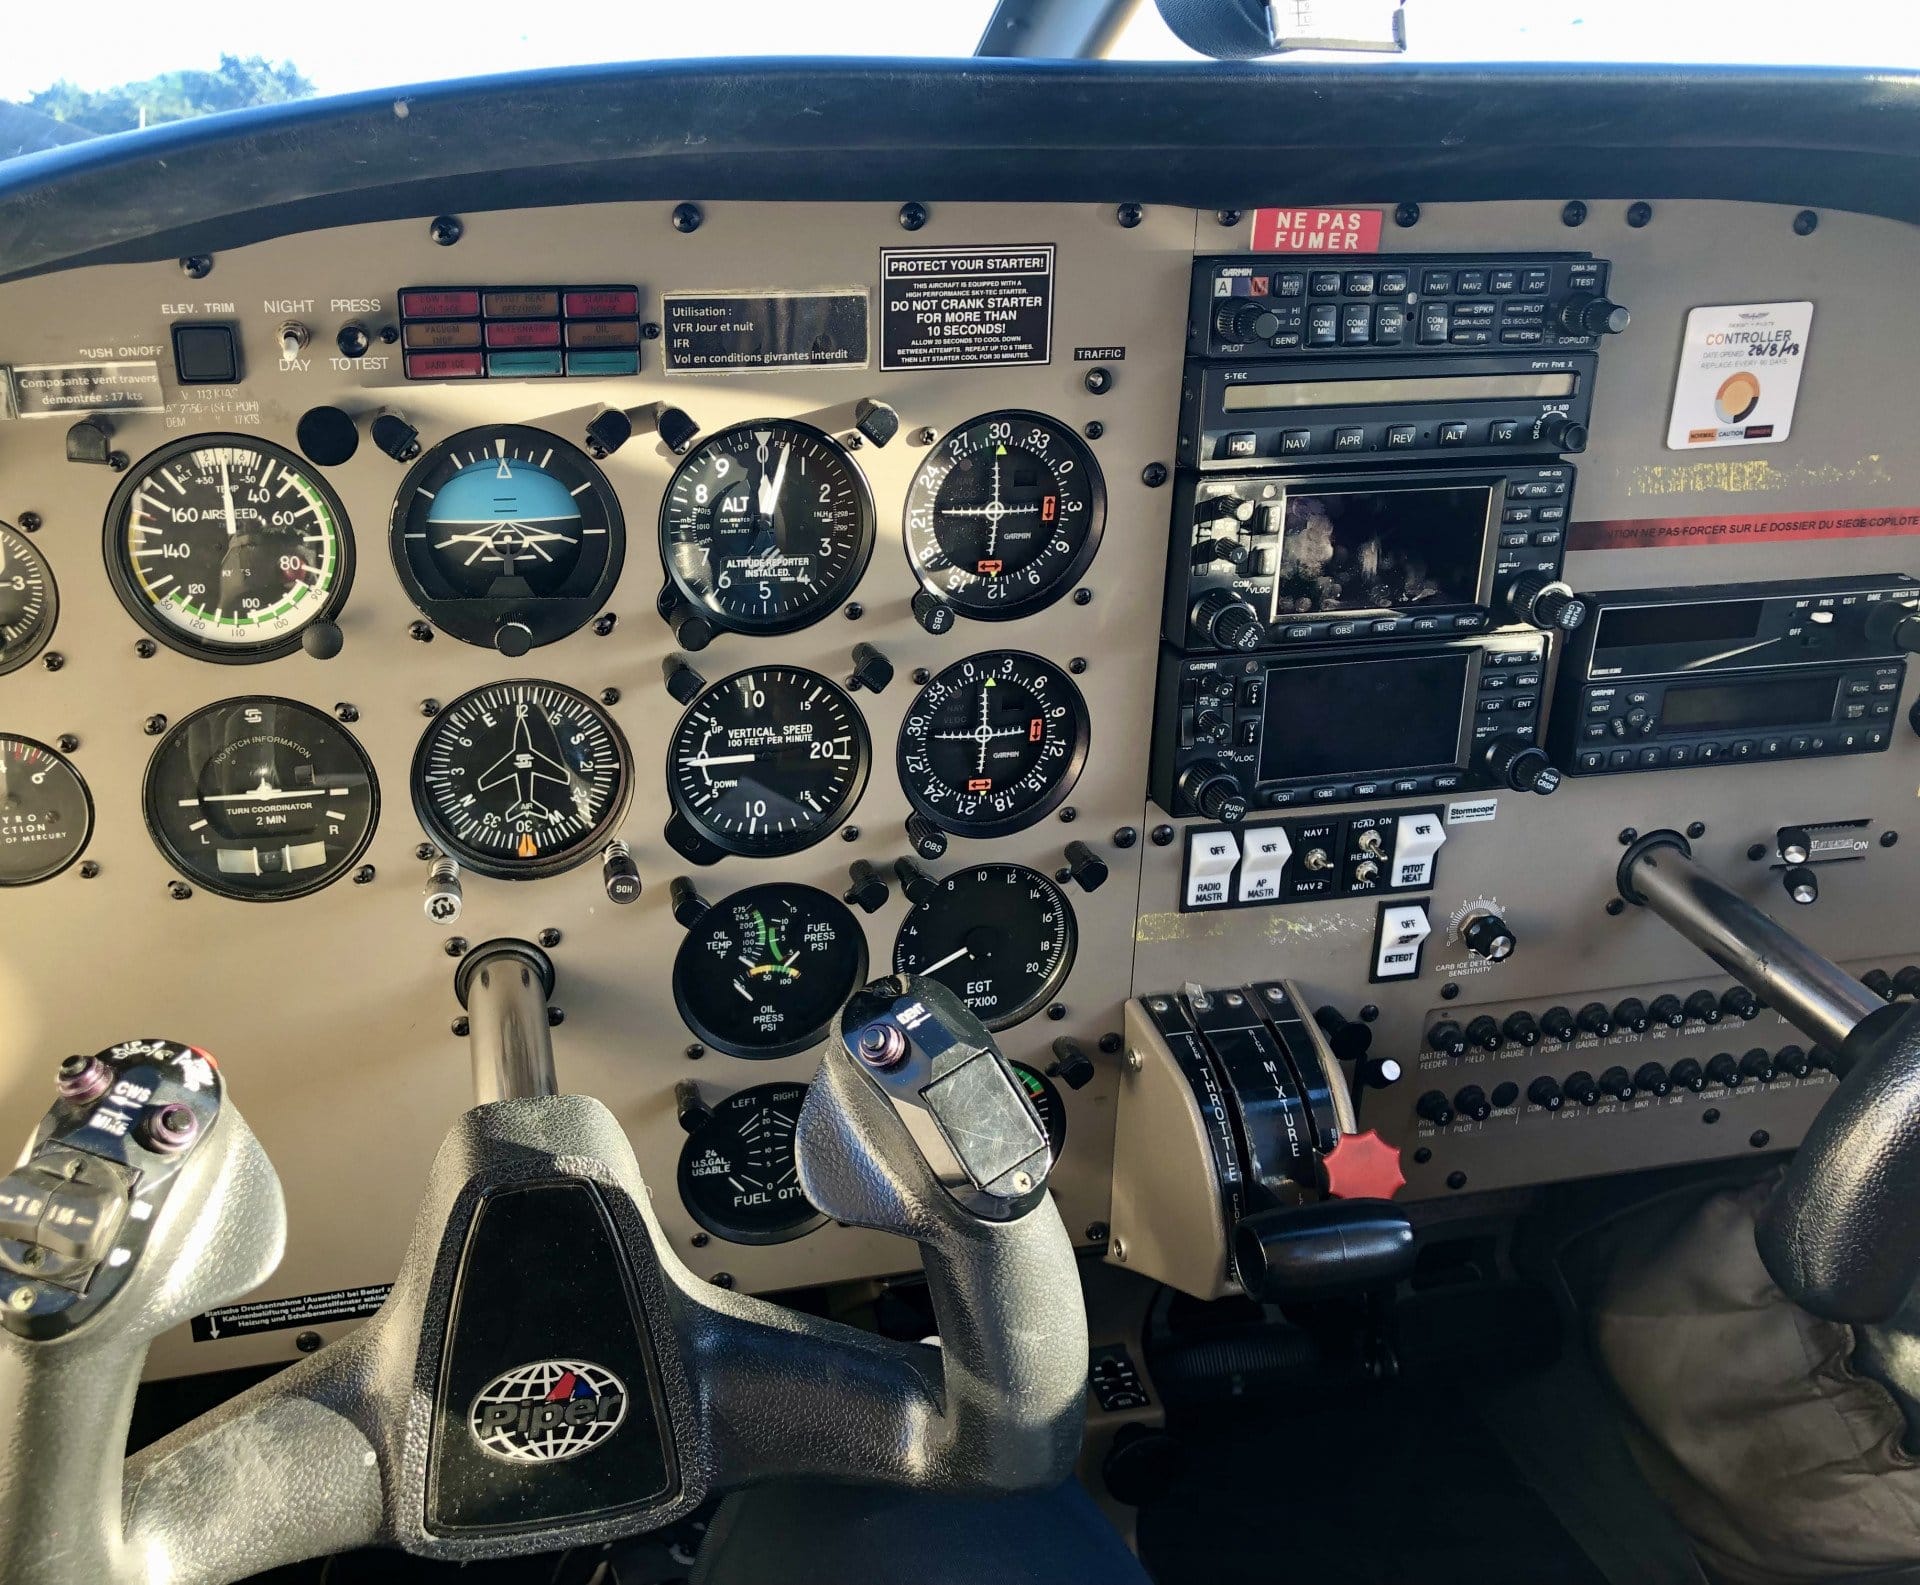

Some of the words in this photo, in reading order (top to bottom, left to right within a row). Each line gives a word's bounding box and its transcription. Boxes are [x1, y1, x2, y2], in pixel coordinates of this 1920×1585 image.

[1277, 212, 1307, 228] NE
[1318, 213, 1361, 229] PAS
[1275, 232, 1358, 249] FUMER
[891, 260, 946, 272] PROTECT
[951, 260, 983, 270] YOUR
[987, 258, 1043, 269] STARTER!
[162, 303, 198, 314] ELEV.
[205, 302, 234, 312] TRIM
[264, 300, 314, 313] NIGHT
[331, 299, 381, 312] PRESS
[891, 302, 909, 311] DO
[913, 300, 938, 310] NOT
[941, 299, 984, 309] CRANK
[988, 297, 1042, 308] STARTER
[673, 307, 726, 317] Utilisation
[917, 313, 941, 323] FOR
[946, 312, 980, 322] MORE
[984, 310, 1017, 320] THAN
[673, 323, 693, 332] VFR
[696, 323, 718, 332] Jour
[721, 323, 731, 332] et
[733, 322, 753, 331] nuit
[927, 326, 940, 336] 10
[944, 324, 1005, 335] SECONDS!
[1706, 330, 1792, 345] CONTROLLER
[674, 339, 689, 348] IFR
[674, 354, 691, 364] Vol
[709, 353, 761, 363] conditions
[764, 352, 809, 363] givrantes
[812, 349, 848, 360] interdit
[1078, 350, 1122, 358] TRAFFIC
[279, 359, 311, 371] DAY
[352, 357, 389, 370] TEST
[21, 379, 89, 388] Composante
[93, 377, 117, 385] vent
[118, 375, 157, 383] travers
[1224, 372, 1248, 381] S-TEC
[127, 392, 143, 400] kts
[989, 423, 1010, 439] 30
[1446, 430, 1464, 440] ALT
[1499, 430, 1512, 440] VS
[1286, 438, 1307, 448] NAV
[1340, 436, 1360, 446] APR
[1393, 433, 1413, 443] REV
[1232, 440, 1253, 451] HDG
[248, 489, 270, 503] 40
[722, 497, 749, 512] ALT
[172, 508, 198, 522] 160
[202, 509, 258, 520] AIRSEED
[272, 511, 294, 525] 60
[1543, 510, 1562, 518] MENU
[1641, 528, 1657, 537] NE
[1658, 527, 1680, 536] PAS
[1682, 525, 1727, 535] FORCER
[1729, 524, 1752, 533] SUR
[1754, 523, 1767, 532] LE
[1770, 520, 1817, 532] DOSSIER
[1819, 520, 1833, 529] DU
[1836, 518, 1867, 529] SIEGE
[1868, 516, 1918, 527] COPILOTE
[1510, 537, 1524, 545] CLR
[1543, 535, 1556, 543] ENT
[163, 544, 190, 558] 140
[280, 556, 300, 570] 80
[727, 559, 764, 568] ALTITUDE
[764, 558, 809, 567] REPORTER
[1538, 562, 1554, 571] GPS
[746, 569, 790, 577] INSTALLED.
[1421, 621, 1434, 629] FPL
[1459, 618, 1478, 626] PROC
[1336, 626, 1351, 635] OBS
[1190, 662, 1217, 671] GARMIN
[744, 690, 765, 709] 10
[728, 727, 775, 738] VERTICAL
[783, 724, 813, 735] SPEED
[728, 739, 742, 747] 100
[744, 737, 764, 746] FEET
[767, 736, 783, 745] PER
[785, 734, 812, 743] MINUTE
[215, 752, 227, 765] NO
[225, 738, 251, 755] PITCH
[252, 736, 312, 759] INFORMATION
[810, 741, 833, 759] 20
[714, 780, 738, 788] DOWN
[226, 807, 250, 815] TURN
[251, 802, 313, 813] COORDINATOR
[1451, 805, 1494, 816] Stormscope
[256, 817, 264, 825] 2
[266, 815, 286, 824] MIN
[1353, 819, 1375, 829] TCAD
[1379, 817, 1392, 825] ON
[22, 832, 67, 842] MERCURY
[1304, 829, 1321, 837] NAV
[925, 840, 942, 852] OBS
[1262, 844, 1277, 852] OFF
[1403, 864, 1425, 873] PITOT
[1402, 874, 1421, 883] HEAT
[616, 885, 632, 893] HDG
[1198, 883, 1221, 892] RADIO
[1256, 880, 1266, 888] AP
[1297, 883, 1314, 891] NAV
[1196, 893, 1223, 902] MASTR
[1248, 888, 1274, 897] MASTR
[807, 923, 832, 932] FUEL
[1401, 920, 1416, 928] OFF
[714, 931, 728, 939] OIL
[804, 932, 835, 942] PRESS
[707, 941, 732, 950] TEMP
[811, 943, 827, 951] PSI
[1385, 953, 1414, 963] DETECT
[1449, 967, 1491, 977] SENSITIVITY
[967, 980, 992, 994] EGT
[761, 1006, 775, 1014] OIL
[753, 1014, 784, 1023] PRESS
[761, 1023, 776, 1032] PSI
[1420, 1060, 1447, 1070] FEEDER
[773, 1090, 799, 1101] RIGHT
[732, 1097, 756, 1109] LEFT
[1264, 1061, 1300, 1156] MIXTURE
[1200, 1068, 1236, 1181] THROTTLE
[692, 1165, 730, 1176] USABLE
[734, 1193, 771, 1207] FUEL
[778, 1186, 803, 1200] QTY
[347, 1290, 359, 1298] bei
[361, 1287, 384, 1295] Bedarf
[481, 1393, 624, 1440] Piper
